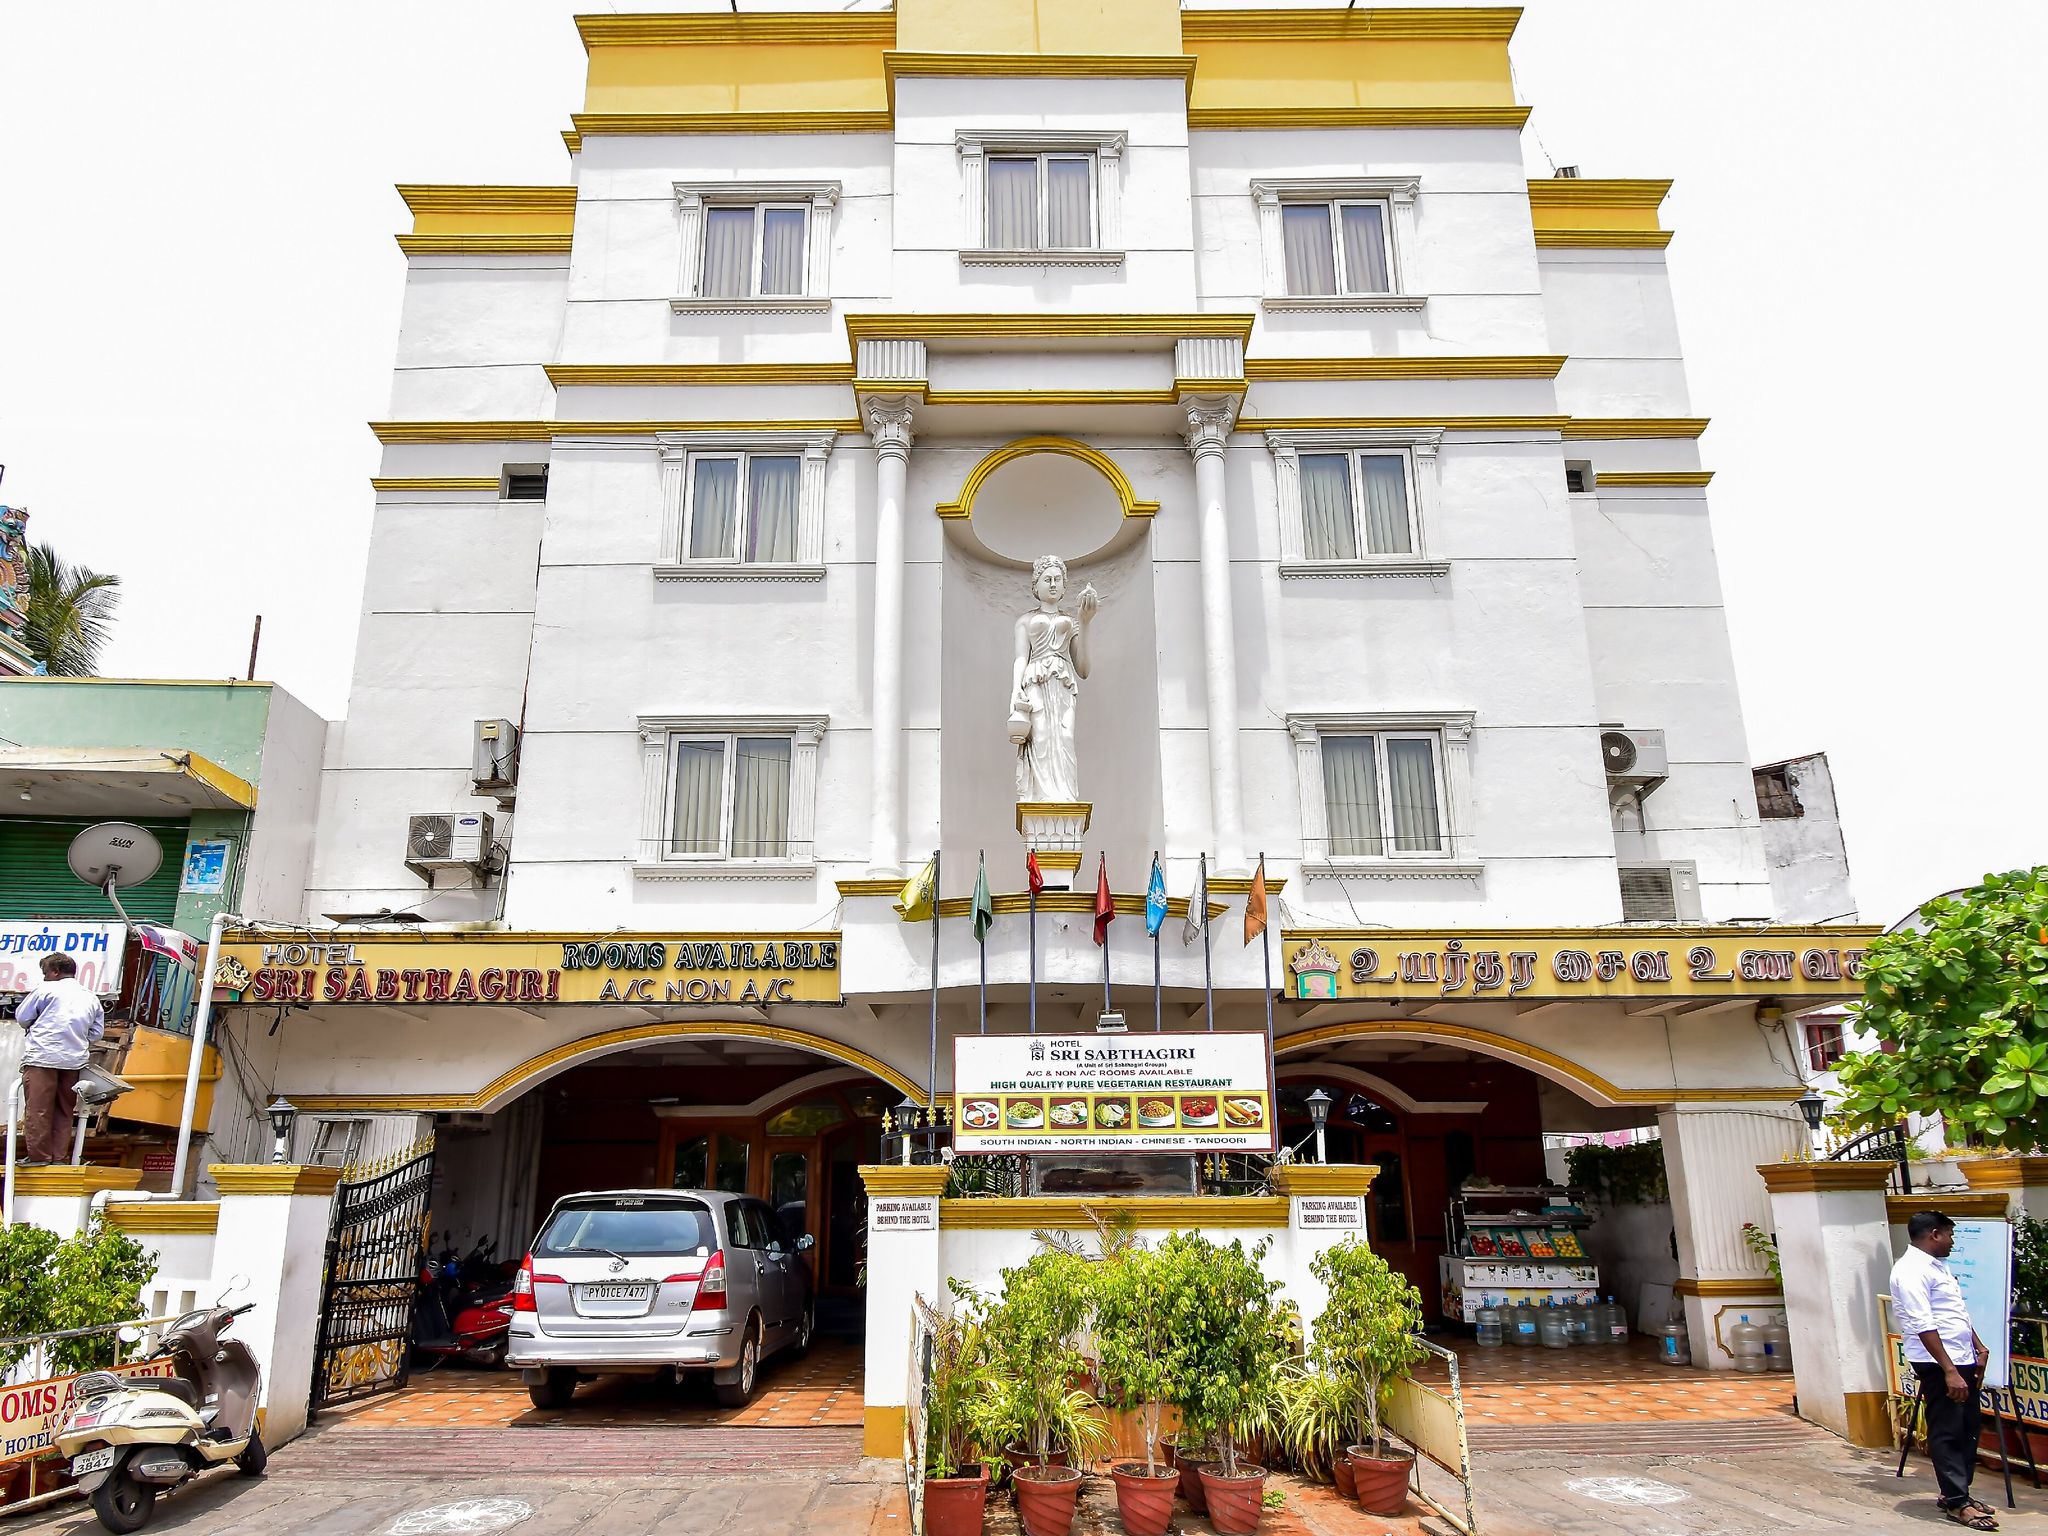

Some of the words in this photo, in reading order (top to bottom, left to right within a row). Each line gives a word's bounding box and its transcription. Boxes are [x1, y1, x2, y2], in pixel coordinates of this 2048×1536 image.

[64, 933, 109, 951] DTH
[263, 943, 365, 965] HOTEL
[561, 942, 665, 969] ROOMS
[674, 942, 837, 970] AVAILABLE
[1350, 940, 1537, 996] உயர்தர
[1552, 949, 1672, 983] சைவ
[252, 968, 317, 1000] SRI
[323, 968, 560, 1000] SABTHAGIRI
[599, 978, 655, 1000] A/C
[666, 978, 731, 1000] NON
[740, 978, 794, 1000] A/C
[1050, 1050, 1080, 1061] SRI
[1084, 1048, 1196, 1061] SABTHAGIRI
[1138, 1068, 1193, 1076] AVAILABLE
[990, 1080, 1017, 1089] HIGH
[1019, 1080, 1064, 1090] QUALITY
[1066, 1080, 1094, 1088] PURE
[1096, 1079, 1162, 1088] VEGETARIAN
[1164, 1078, 1233, 1087] RESTAURANT
[876, 1203, 901, 1212] PARKING
[901, 1203, 932, 1211] AVAILABLE
[1301, 1202, 1326, 1210] PARKING
[1327, 1202, 1358, 1210] AVAILABLE
[877, 1216, 898, 1225] BEHIND
[899, 1216, 911, 1224] THE
[912, 1215, 930, 1224] HOTEL
[1304, 1215, 1324, 1223] BEHIND
[1326, 1215, 1337, 1223] THE
[1338, 1215, 1358, 1223] HOTEL
[5, 1431, 52, 1456] HOTEL
[77, 1457, 110, 1472] 3847
